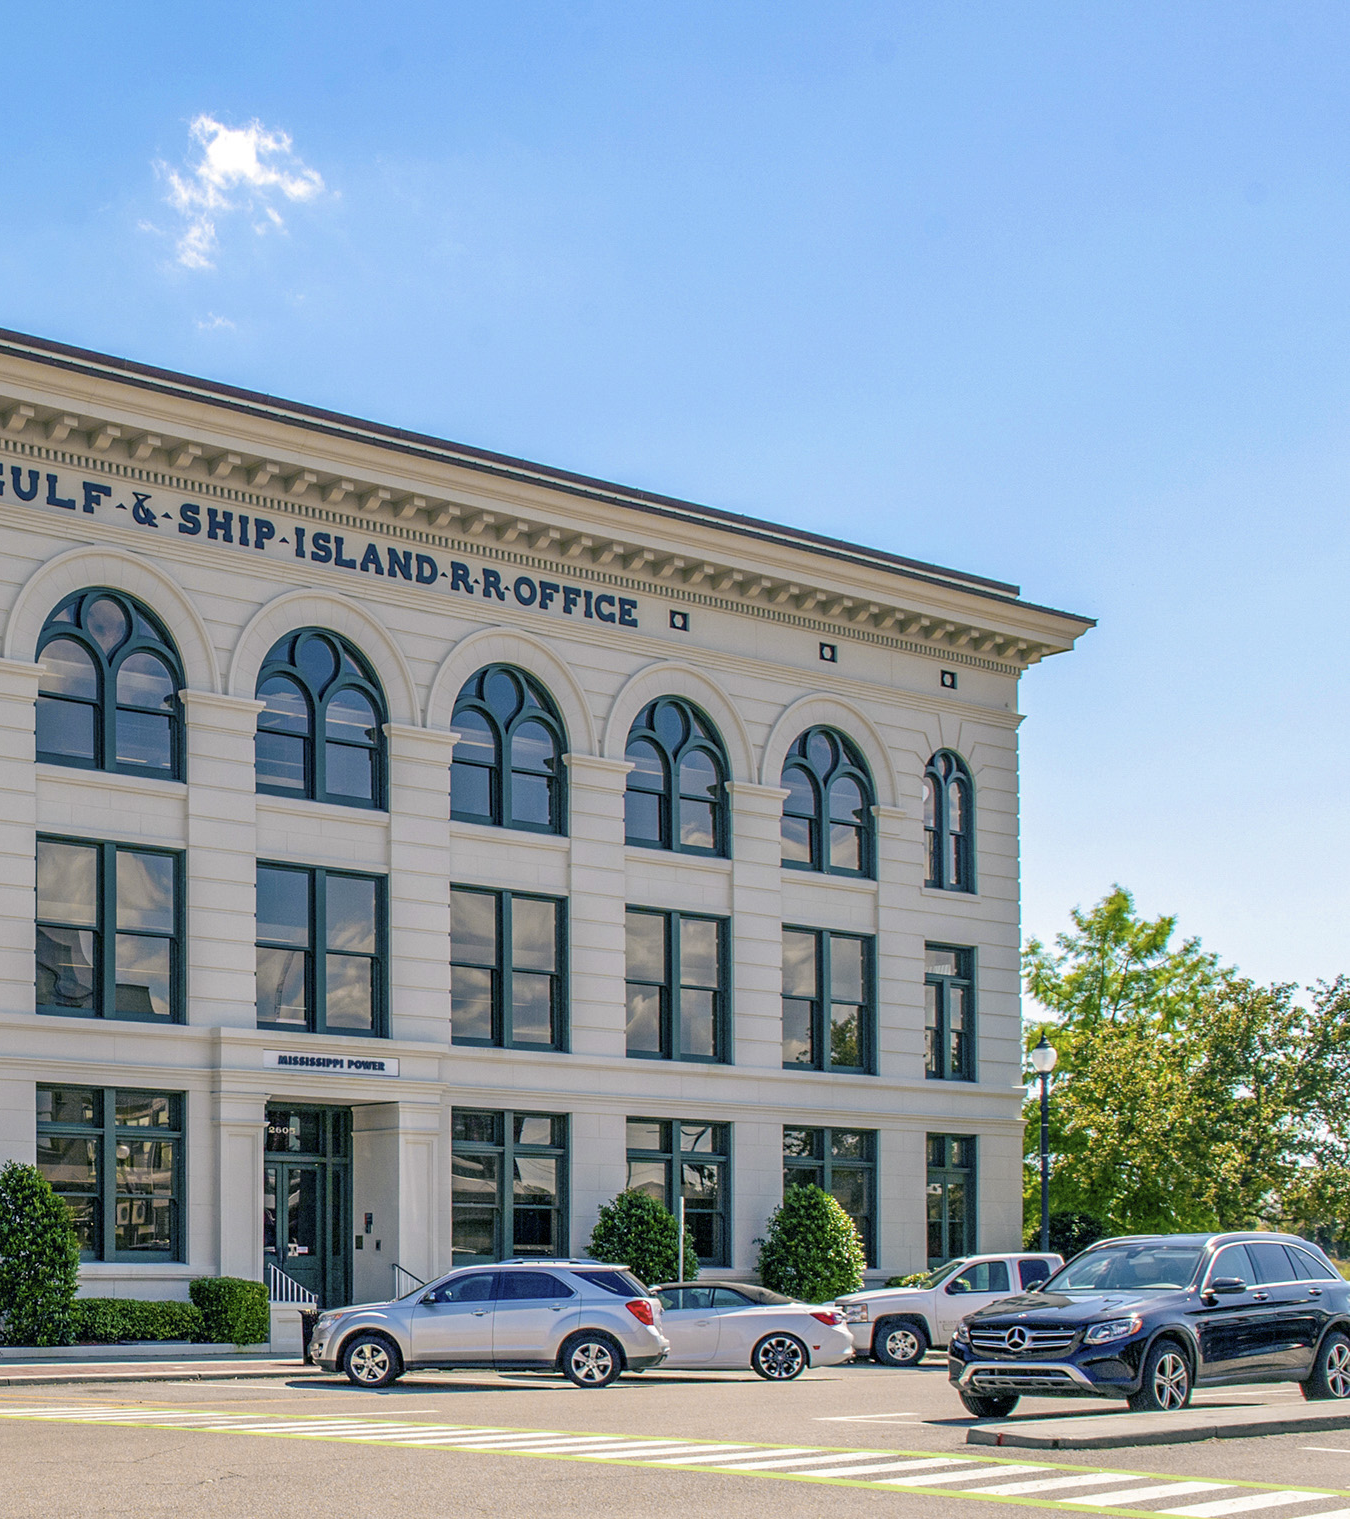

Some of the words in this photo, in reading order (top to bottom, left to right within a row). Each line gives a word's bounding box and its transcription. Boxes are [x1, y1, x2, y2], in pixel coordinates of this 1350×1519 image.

[132, 491, 159, 528] &
[178, 503, 276, 550] SHIP
[295, 527, 439, 585] ISLAND
[514, 576, 639, 628] OFFICE
[277, 1054, 344, 1069] MISSISSIPPI
[347, 1059, 385, 1071] POWER
